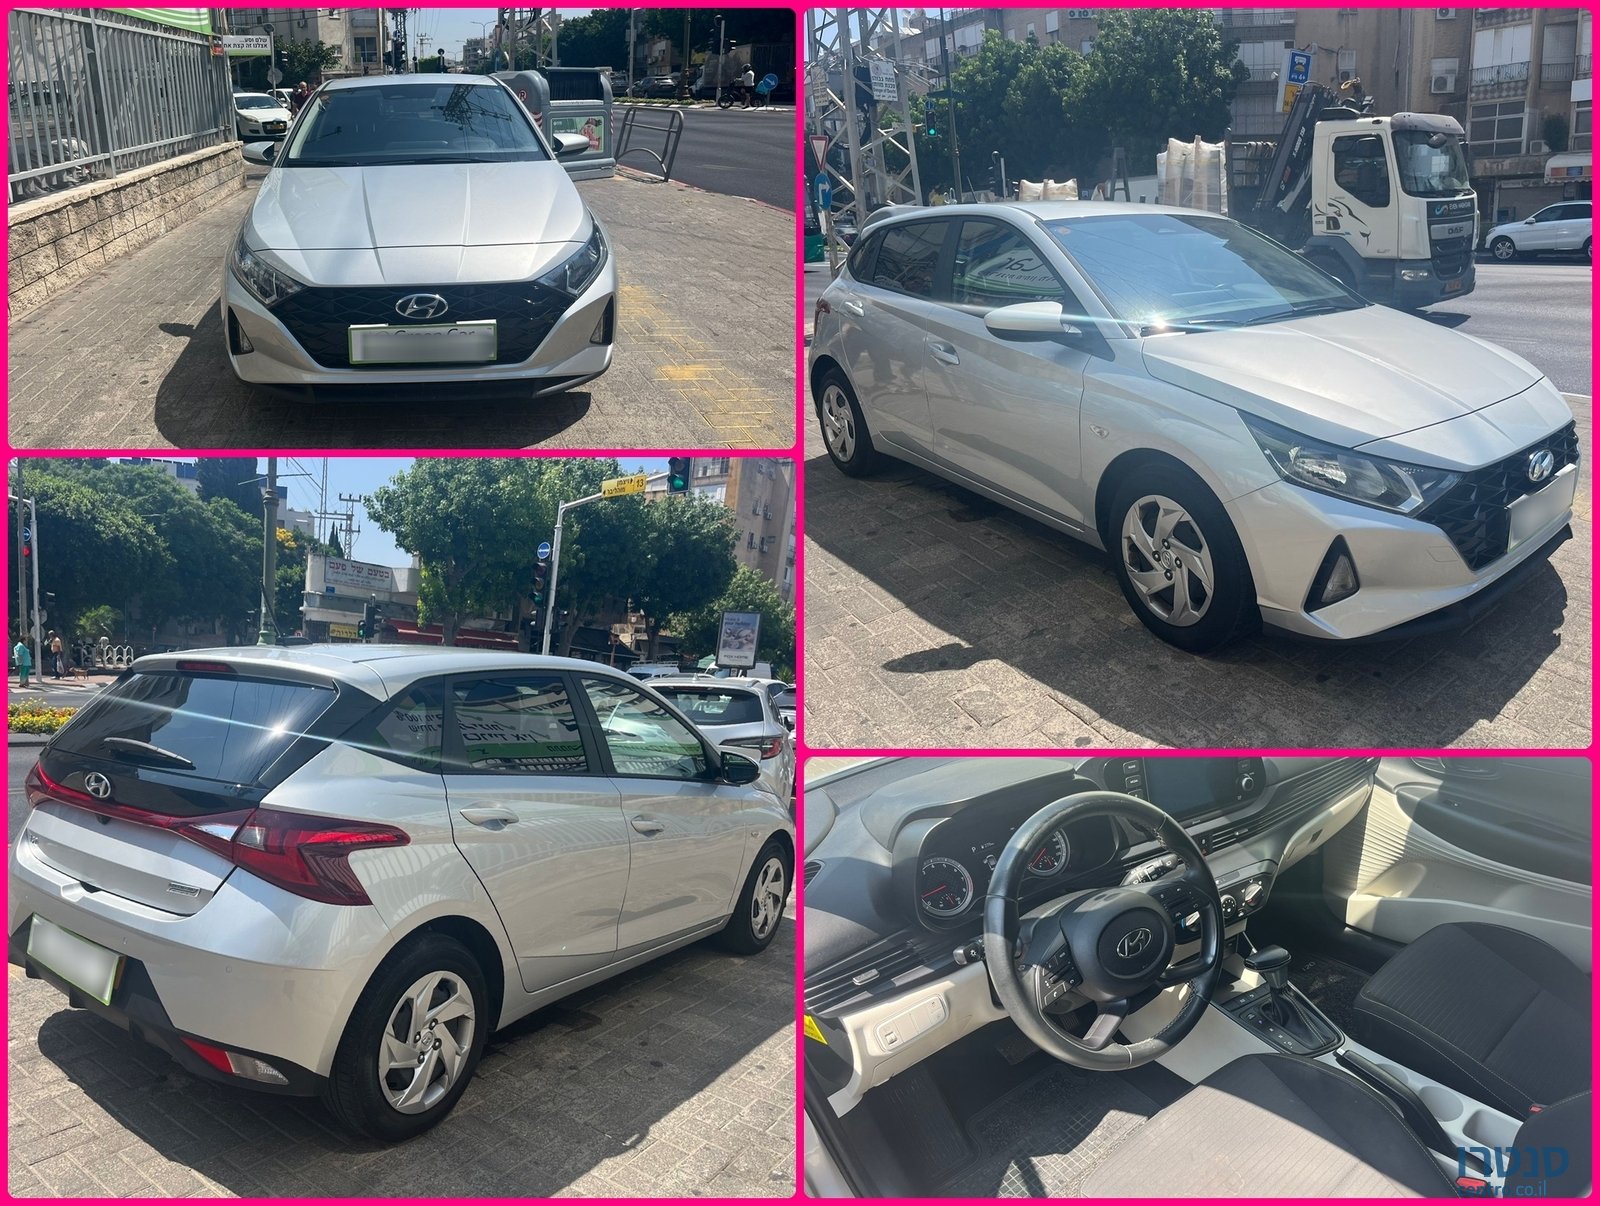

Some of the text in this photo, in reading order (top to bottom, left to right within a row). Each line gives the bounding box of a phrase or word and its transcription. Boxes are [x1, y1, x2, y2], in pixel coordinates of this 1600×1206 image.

[1447, 227, 1464, 235] DAF
[636, 479, 644, 488] 13
[351, 562, 364, 574] של
[367, 568, 390, 579] בטעם
